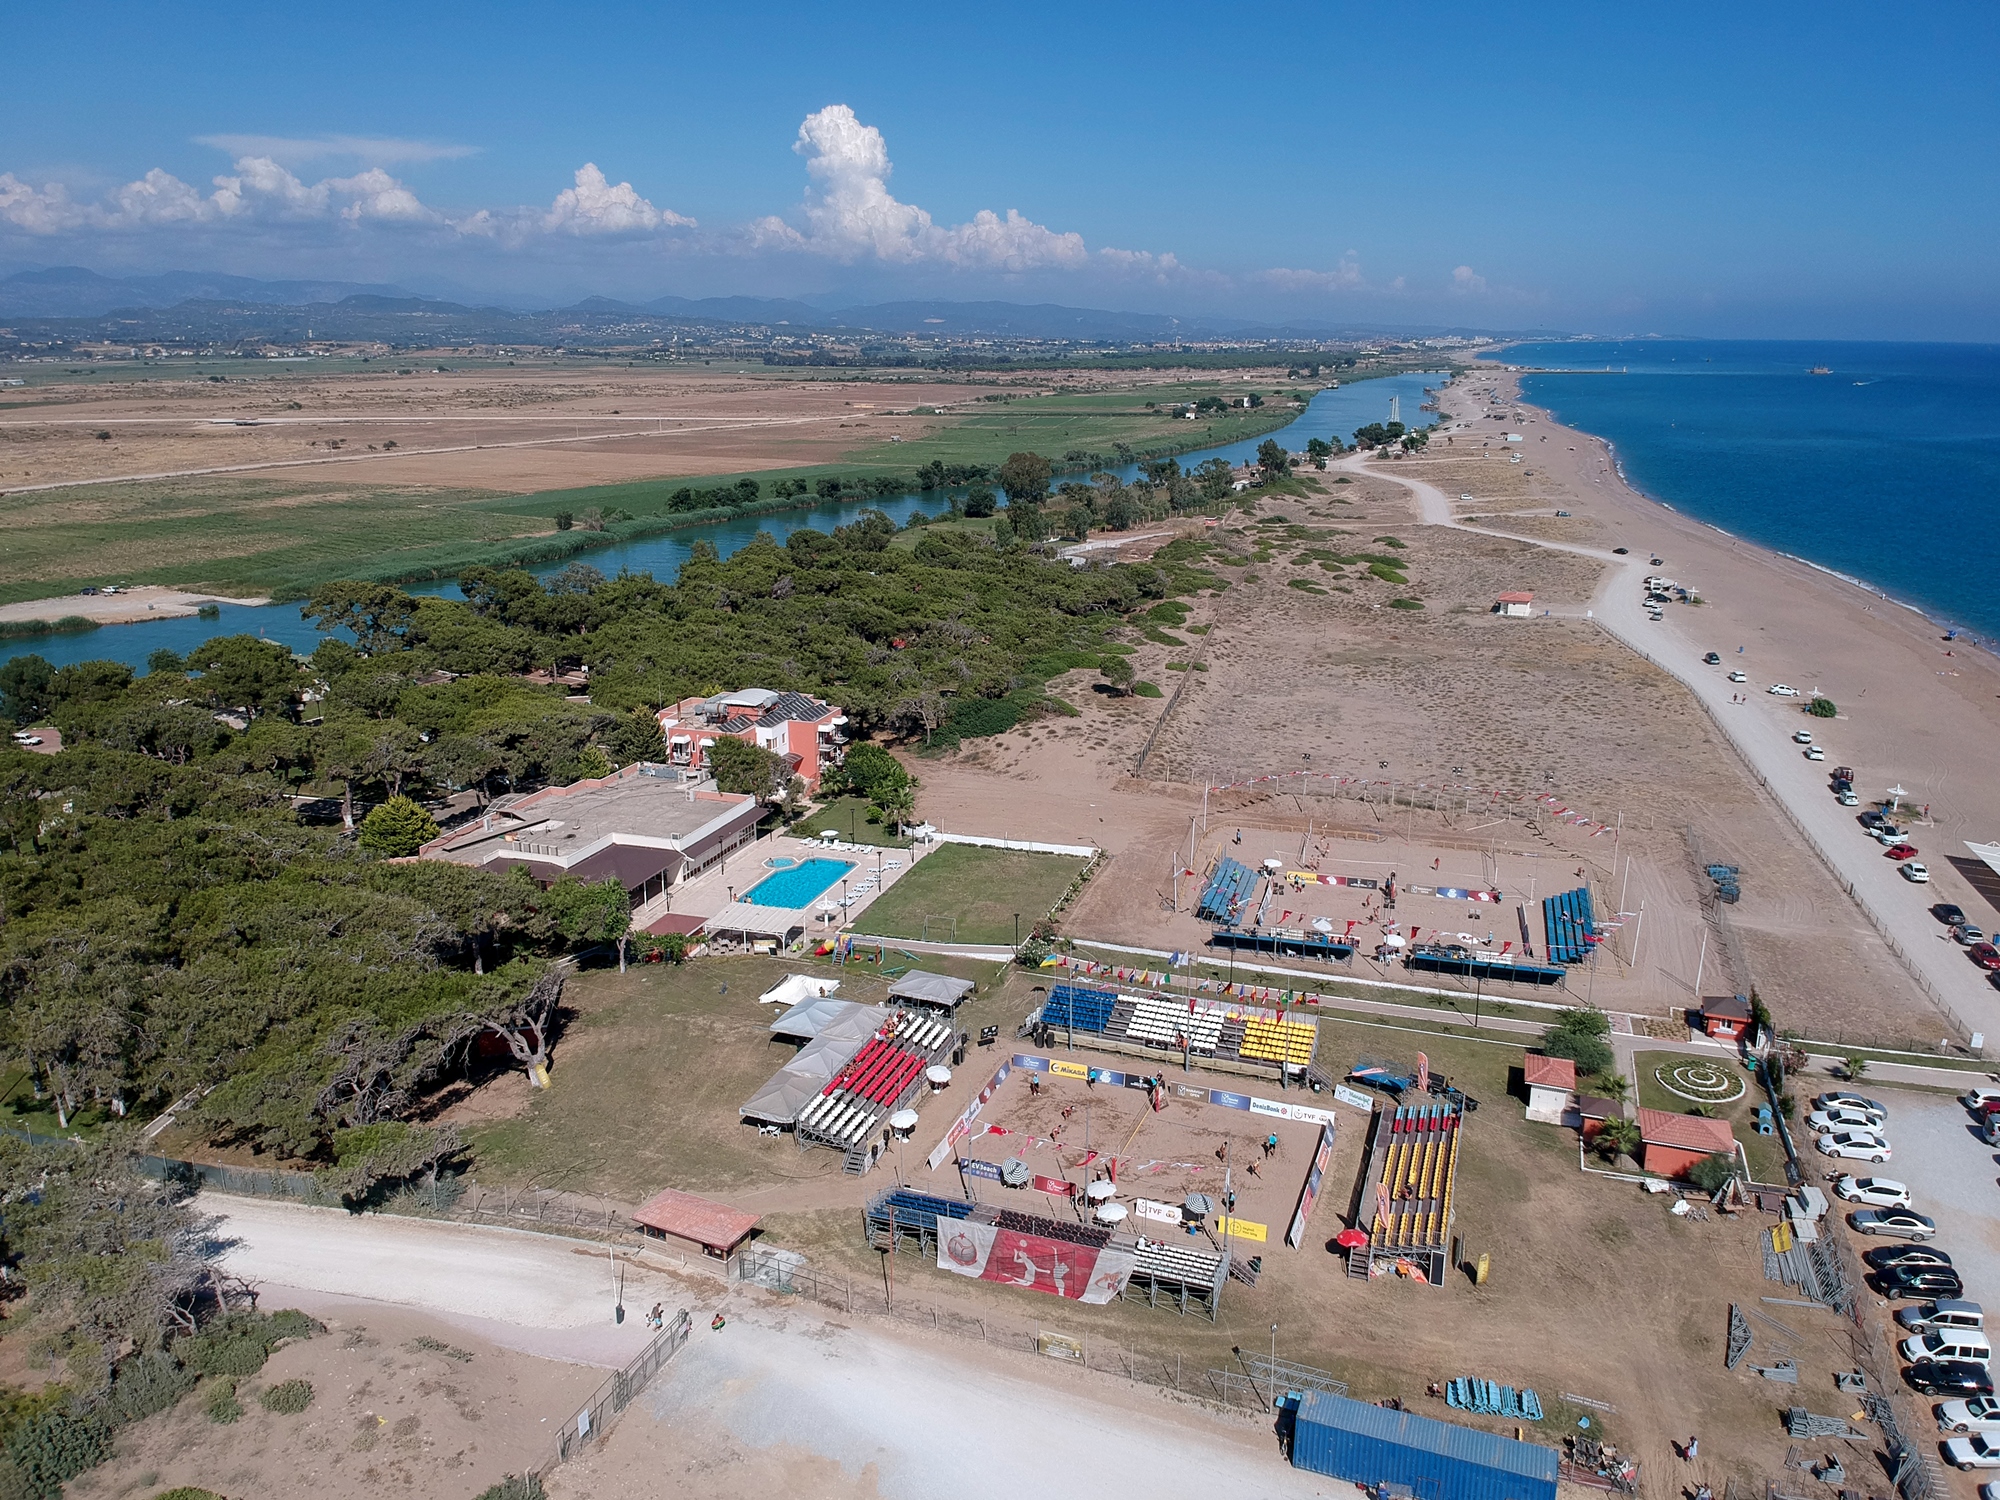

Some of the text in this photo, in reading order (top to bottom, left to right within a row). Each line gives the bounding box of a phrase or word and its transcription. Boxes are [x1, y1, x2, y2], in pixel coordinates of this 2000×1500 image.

[1252, 1101, 1280, 1113] DenizBank
[1303, 1112, 1316, 1120] TVF
[1148, 1206, 1162, 1216] TVF
